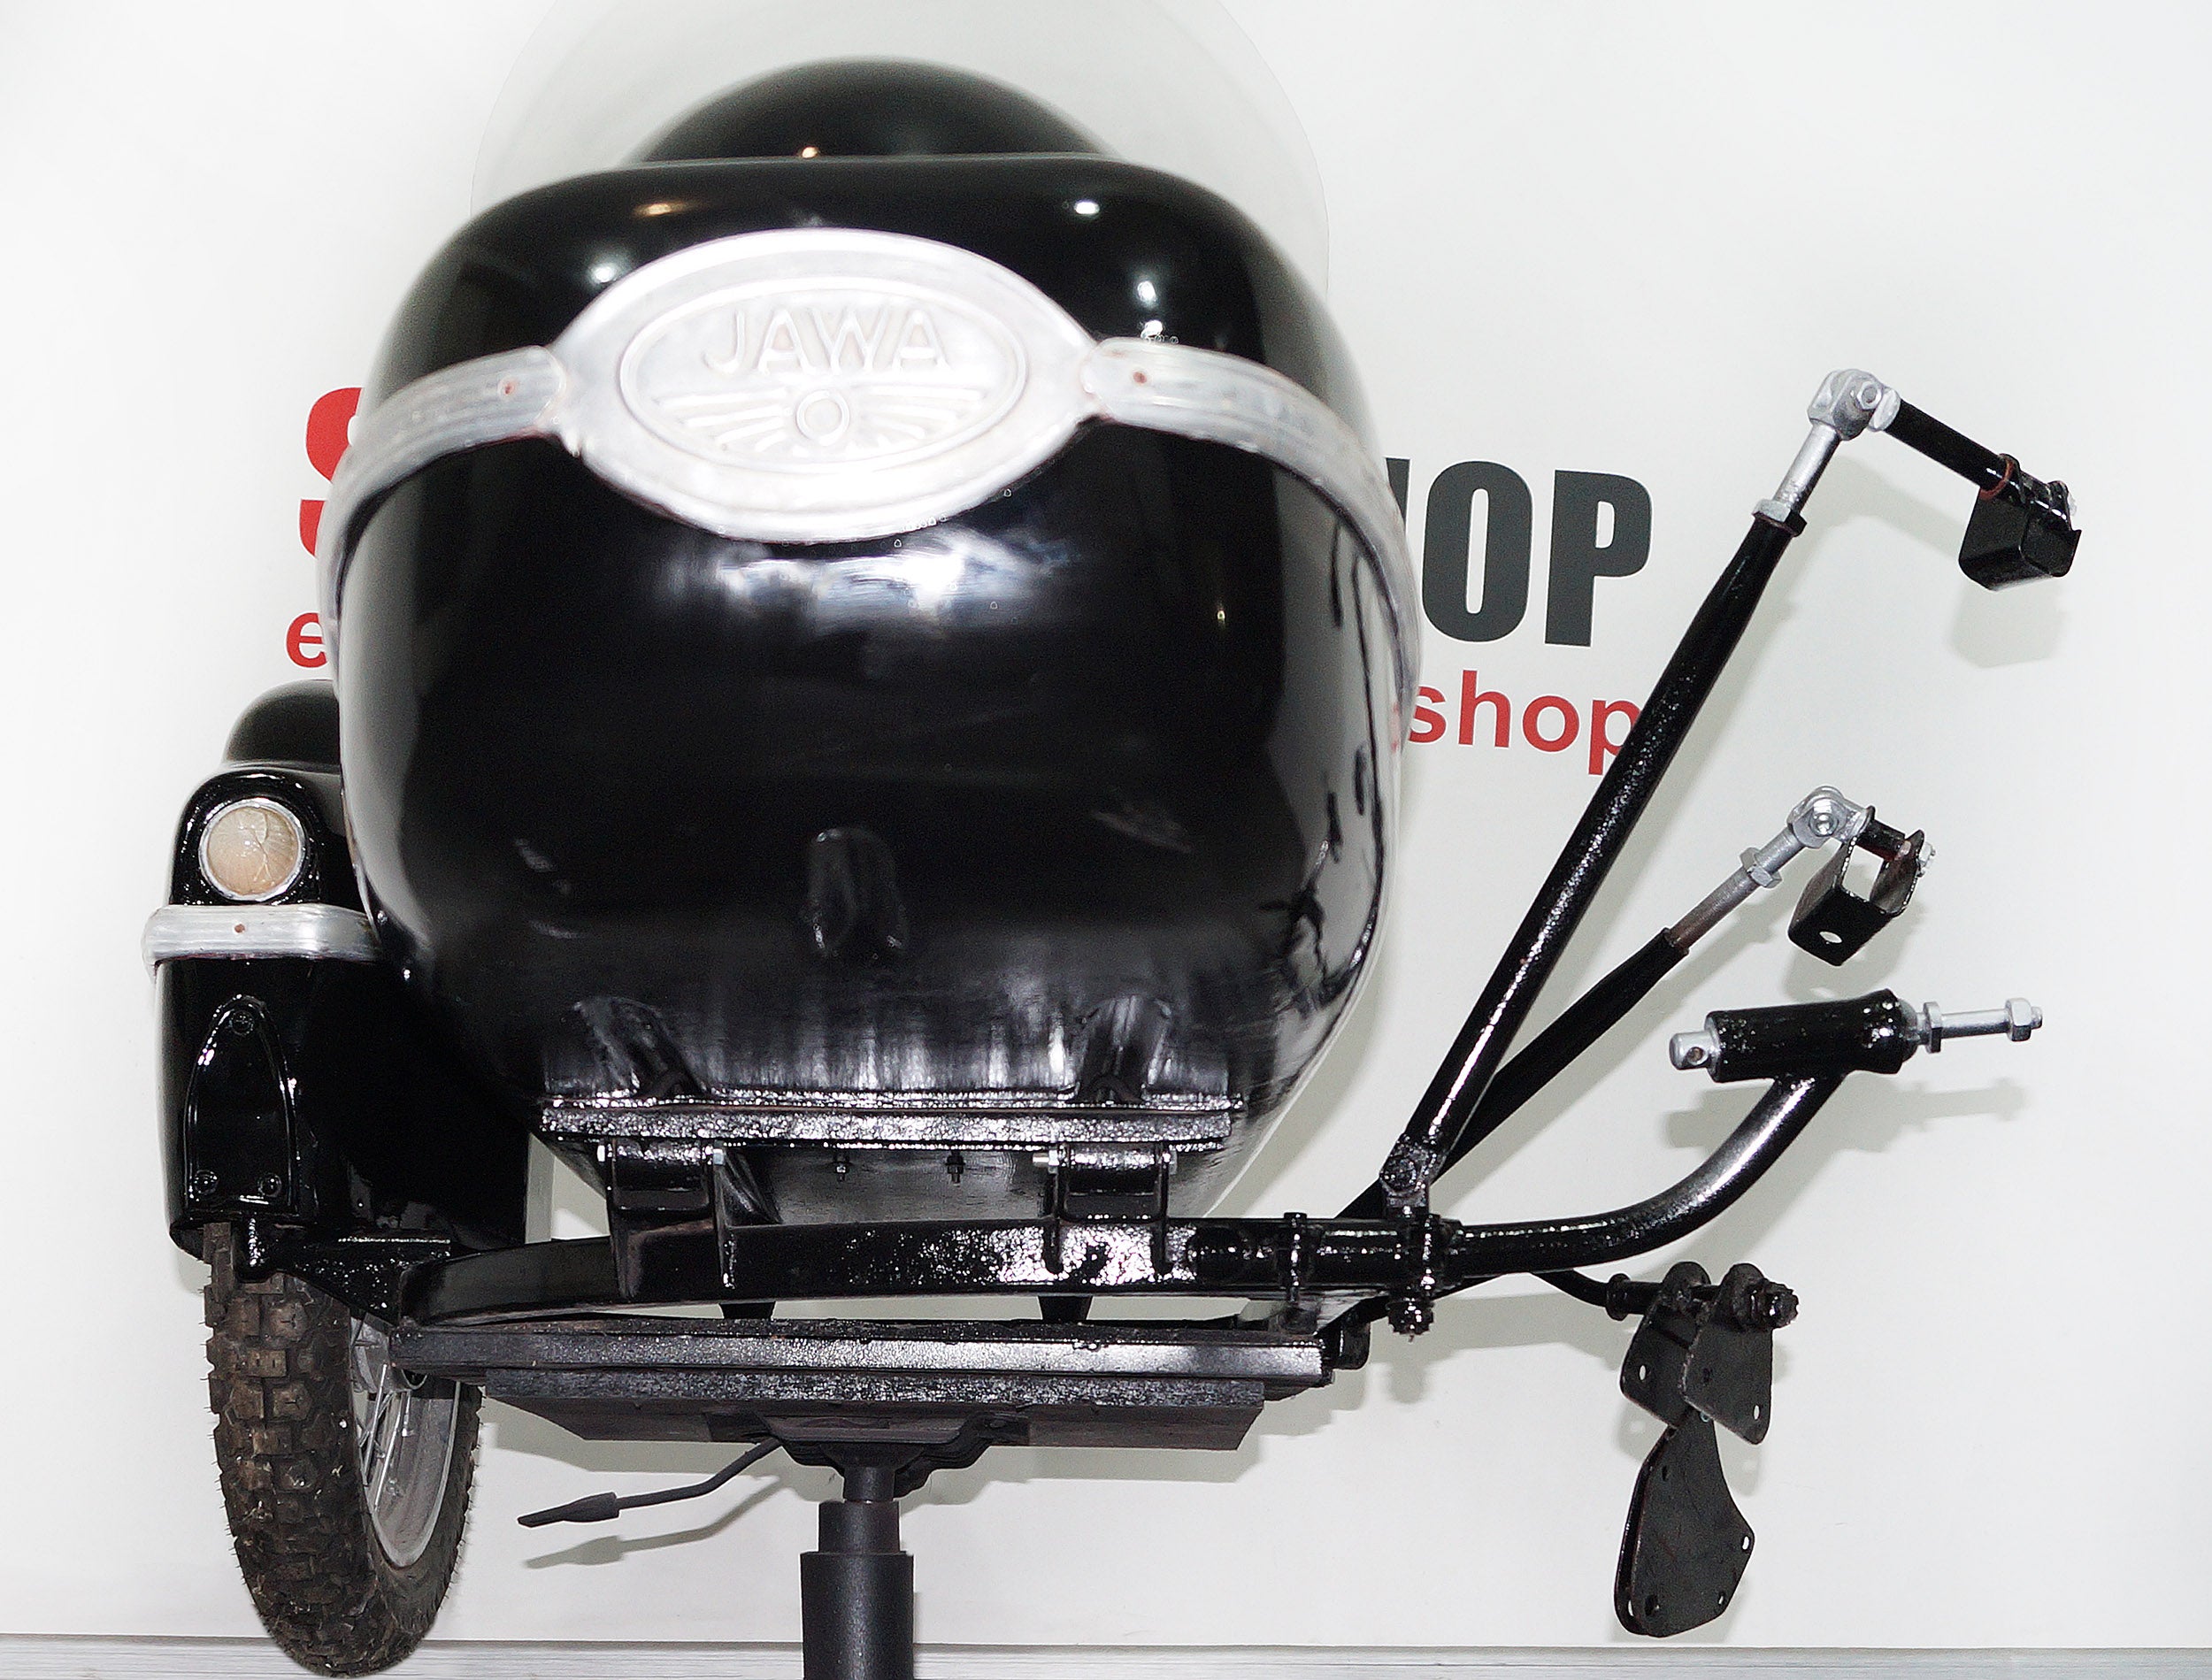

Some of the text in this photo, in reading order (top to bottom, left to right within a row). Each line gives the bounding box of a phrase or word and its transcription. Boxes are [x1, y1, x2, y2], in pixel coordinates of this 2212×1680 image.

[703, 307, 950, 376] JAWA
[1386, 457, 1652, 648] OP
[1408, 670, 1641, 776] shop
